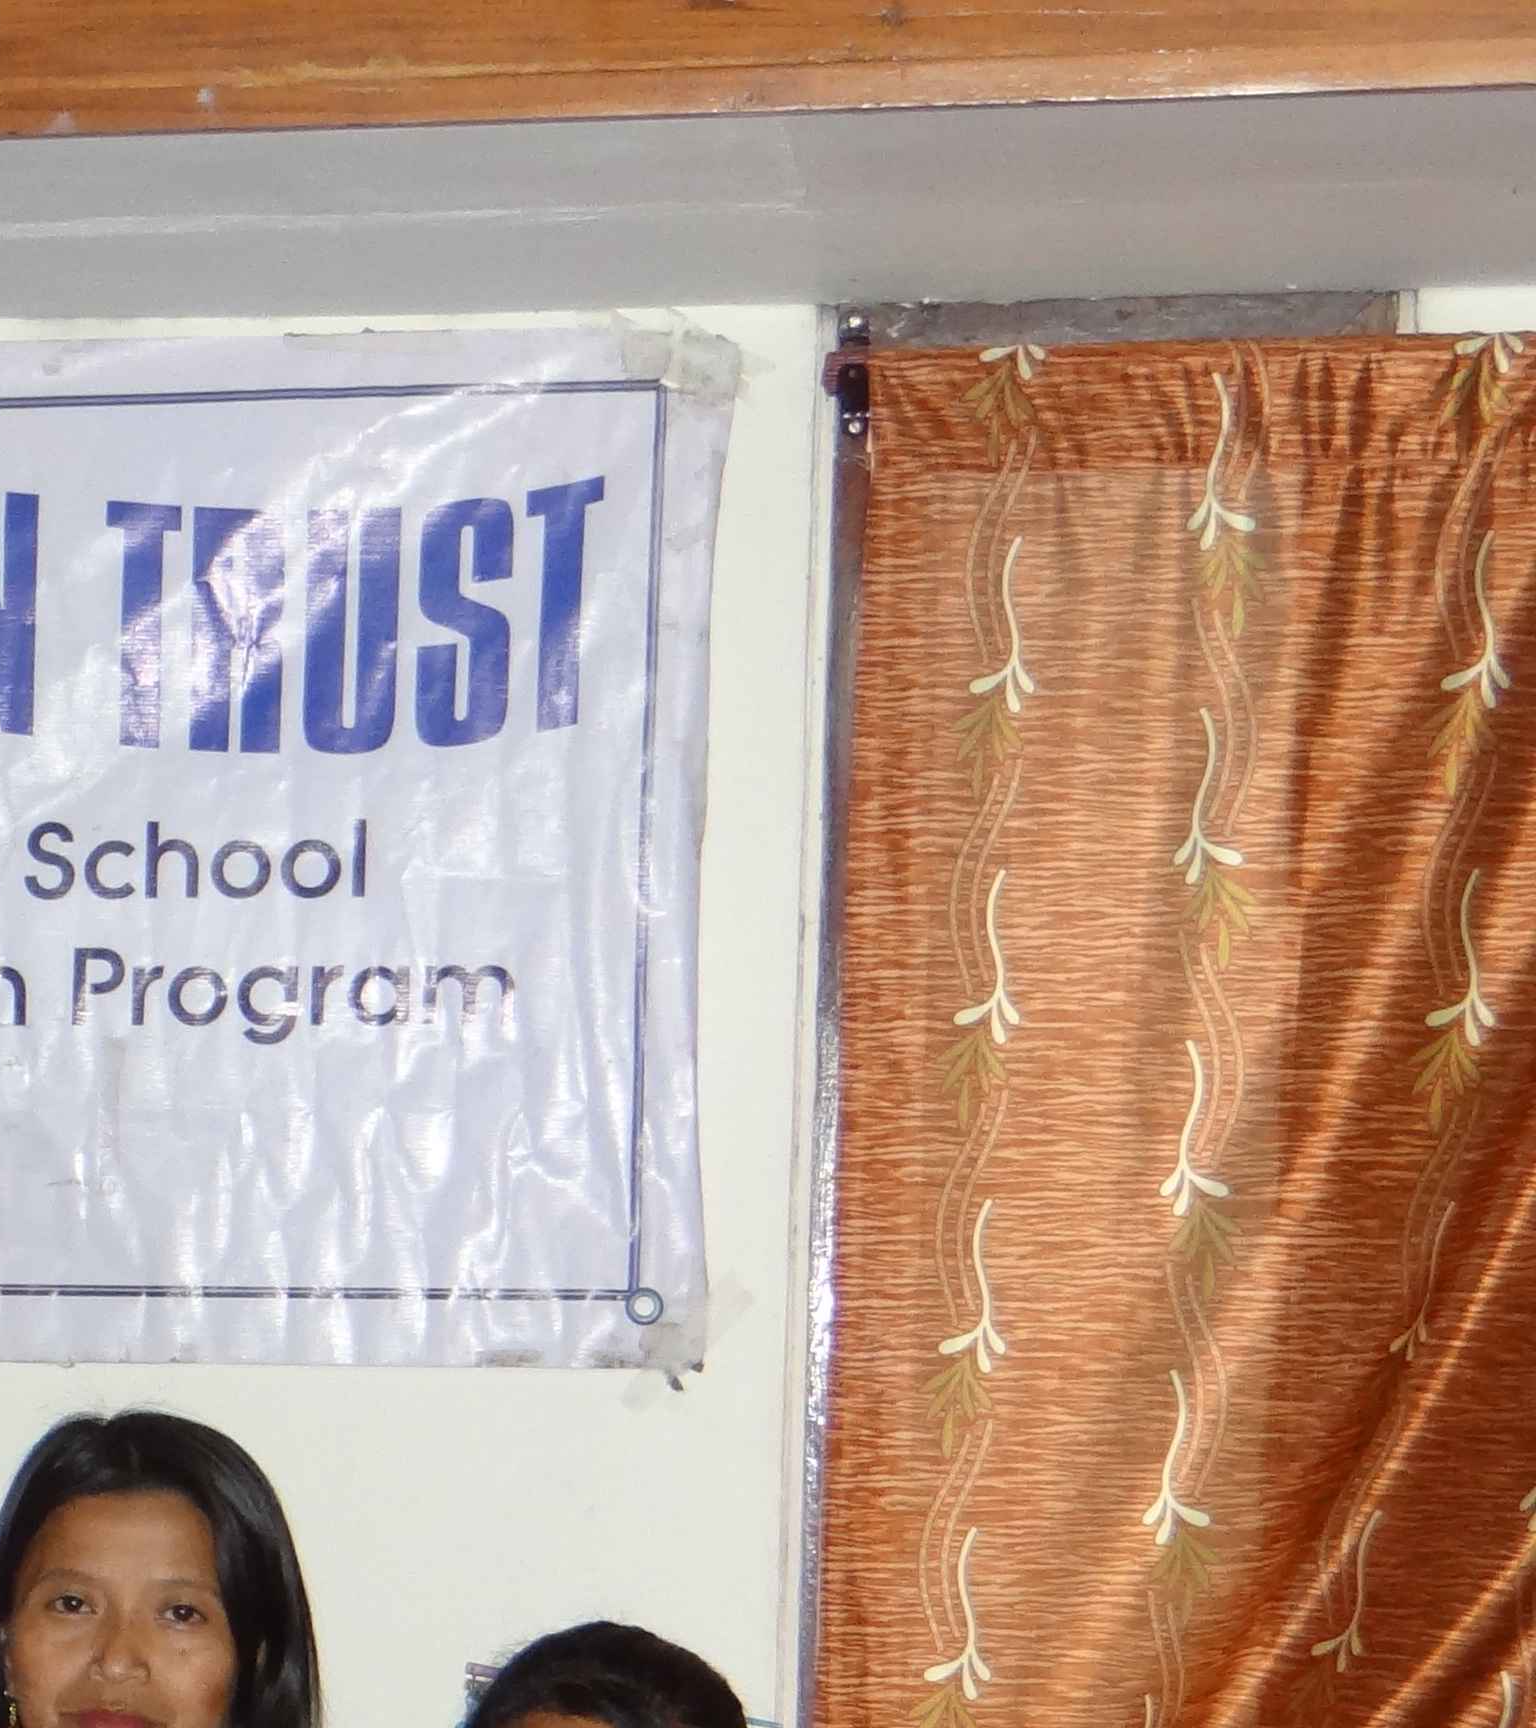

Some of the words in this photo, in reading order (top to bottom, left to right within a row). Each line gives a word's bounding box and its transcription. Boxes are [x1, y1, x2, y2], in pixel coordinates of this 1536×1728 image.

[106, 475, 605, 754] TRUST
[24, 819, 368, 901] School
[72, 947, 516, 1046] Program
